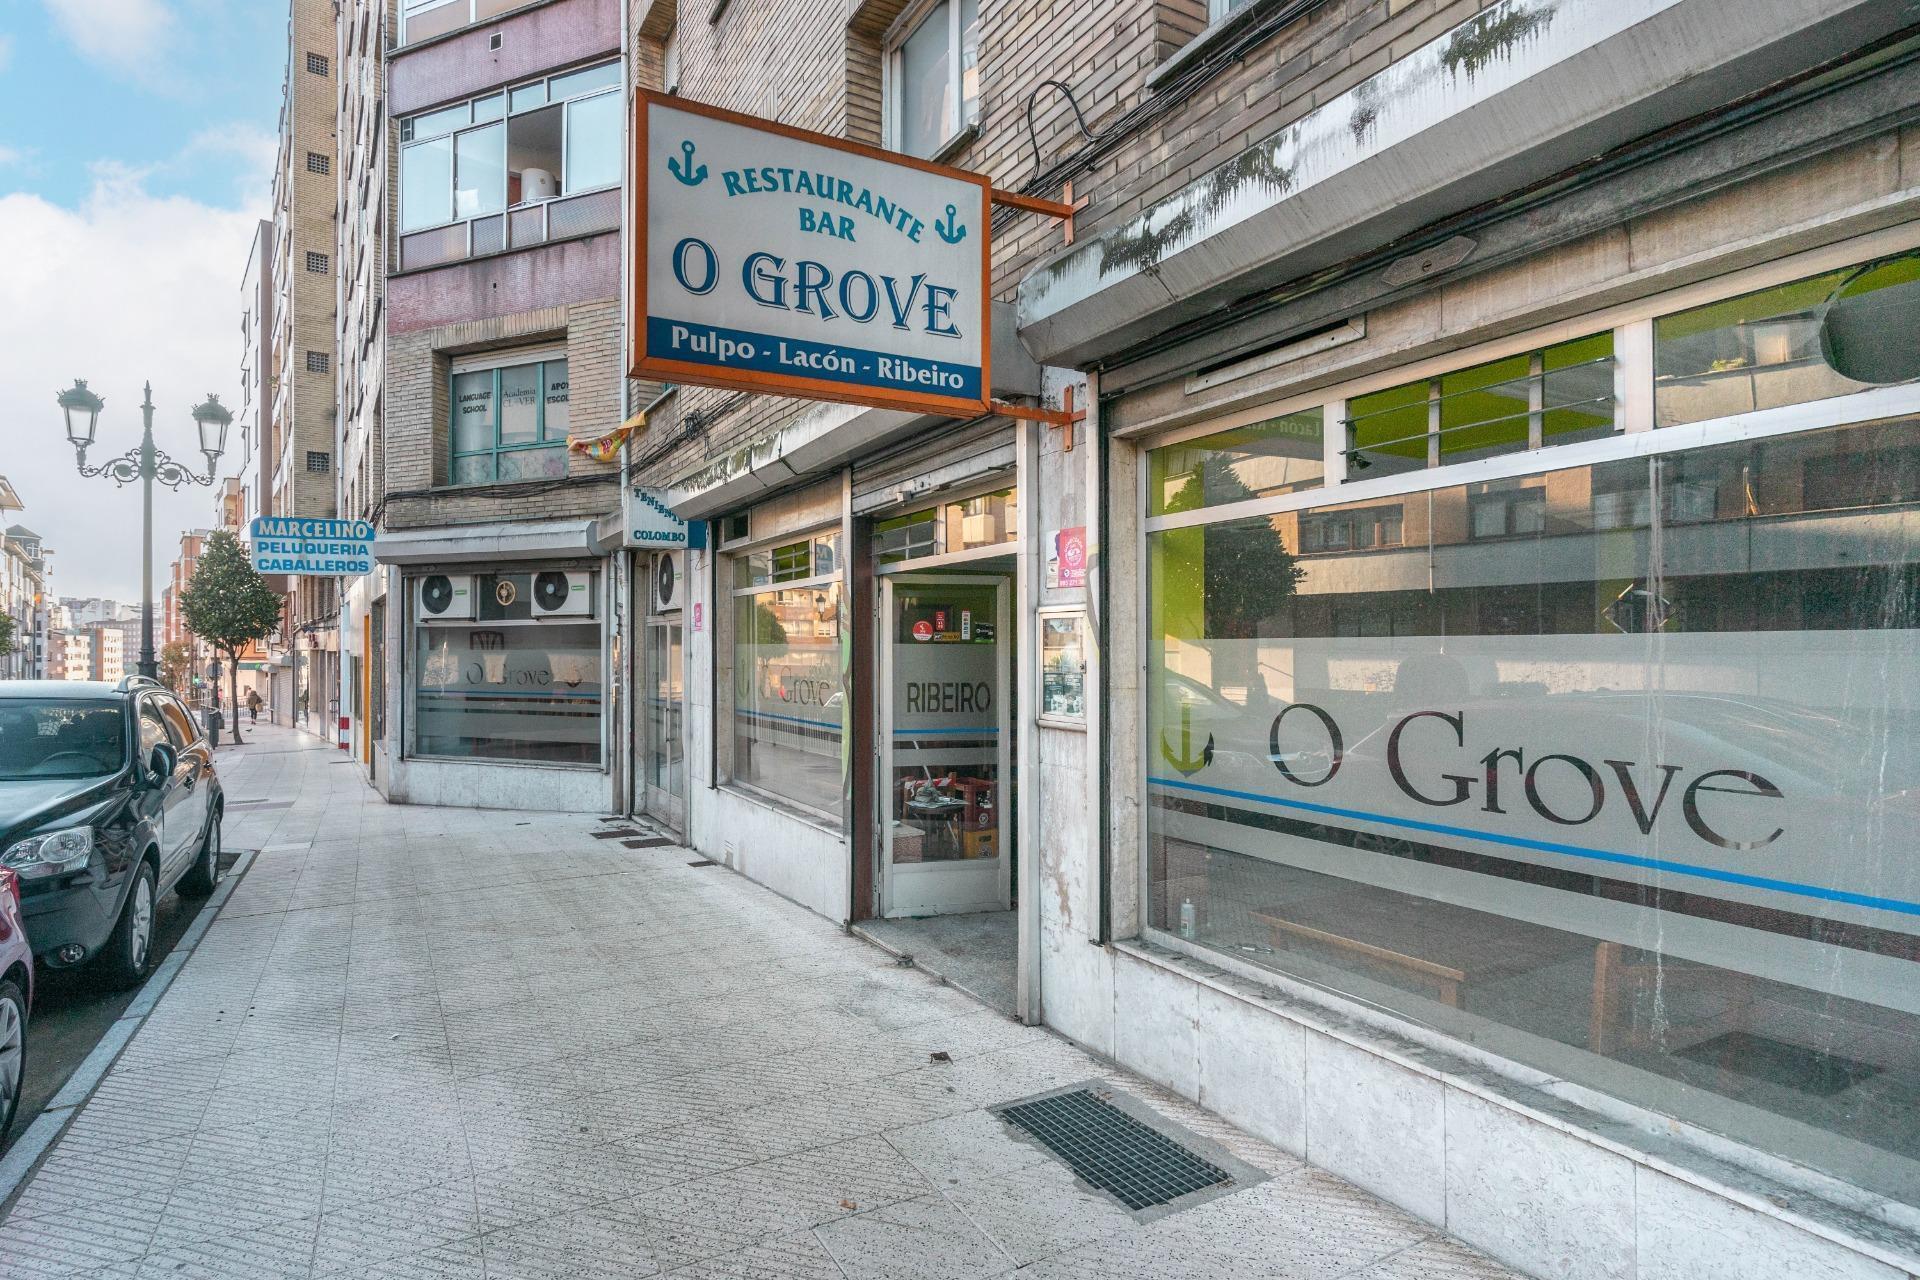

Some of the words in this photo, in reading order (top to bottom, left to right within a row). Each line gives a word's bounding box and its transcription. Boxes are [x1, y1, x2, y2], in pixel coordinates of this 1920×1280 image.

[722, 167, 925, 244] RESTAURANTE
[799, 207, 857, 243] BAR
[672, 237, 720, 296] O
[742, 251, 963, 339] GROVE
[671, 325, 756, 361] Pulpo
[779, 341, 856, 374] Lacón
[878, 357, 964, 390] Ribeiro
[458, 391, 492, 403] LANGUAGE
[503, 387, 536, 398] Academia
[462, 404, 487, 414] SCHOOL
[258, 520, 368, 539] MARCELINO
[633, 530, 686, 542] COLOMBO
[257, 541, 369, 556] PELUQUERIA
[257, 558, 369, 572] CABALLEROS
[466, 662, 484, 685] O
[906, 681, 991, 714] RIBEIRO
[1268, 702, 1344, 788] O
[1386, 709, 1785, 851] Grove
